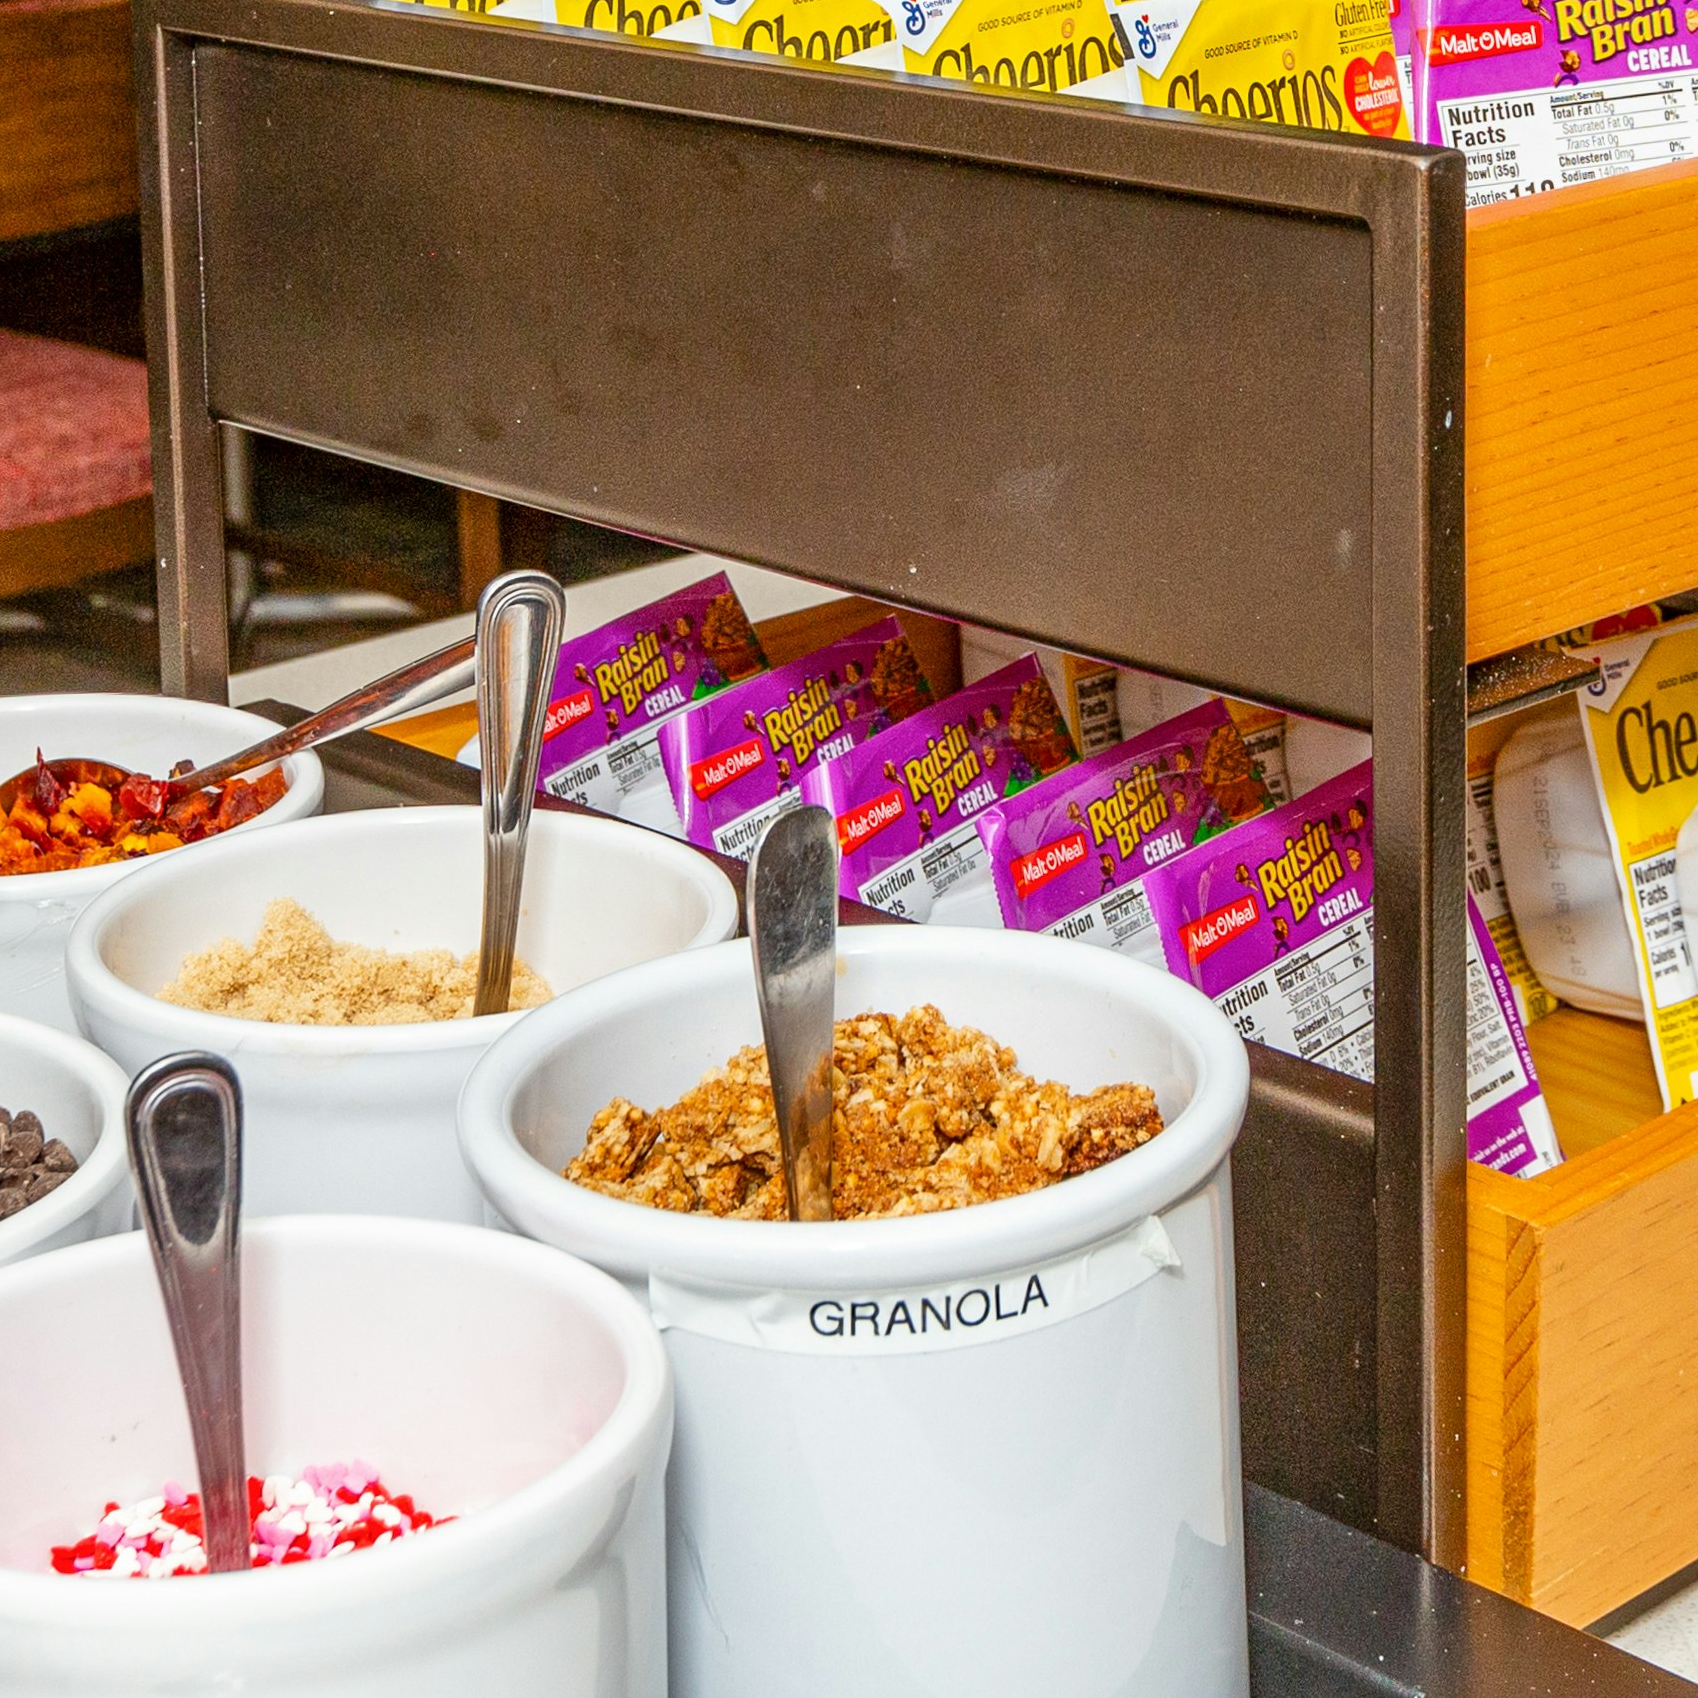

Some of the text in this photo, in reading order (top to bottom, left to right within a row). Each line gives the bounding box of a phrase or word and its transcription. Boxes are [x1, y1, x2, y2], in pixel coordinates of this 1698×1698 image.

[926, 9, 944, 19] Mills
[977, 0, 1083, 33] GOOD SOURCE OF VITAMIN D
[1152, 19, 1179, 33] General
[1334, 0, 1371, 27] Gluten
[1155, 32, 1172, 42] Mills
[1204, 29, 1299, 60] GOOD SOURCE OF VITAMIN D
[1590, 5, 1677, 65] Bran
[1627, 43, 1693, 73] CEREAL
[1447, 100, 1535, 127] Nutrition
[1551, 94, 1678, 120] Total Fat 0.5g 1%
[1562, 109, 1680, 135] Saturated Fat 0g 0%
[1452, 126, 1508, 148] Facts
[1566, 133, 1620, 150] Trans Fat 0g
[1465, 149, 1517, 167] rving size
[1558, 141, 1685, 167] Cholesterol 0mg 0%
[1466, 162, 1521, 182] bowl (35g)
[1561, 168, 1596, 184] Sodium
[1465, 189, 1508, 207] Calories
[592, 631, 662, 705] Raisin
[619, 653, 670, 718] Bran
[644, 684, 687, 718] CEREAL
[762, 673, 832, 755] Raisin
[789, 701, 843, 768] Bran
[816, 733, 855, 766] CEREAL
[551, 763, 601, 797] Nutrition
[903, 721, 971, 806] Raisin
[931, 749, 982, 818] Bran
[957, 780, 999, 817] CEREAL
[1085, 763, 1160, 849] Raisin
[1113, 789, 1170, 862] Bran
[1142, 828, 1186, 866] CEREAL
[1256, 819, 1332, 912] Raisin
[866, 866, 916, 908] Nutrition
[1284, 848, 1346, 925] Bran
[1638, 884, 1669, 909] Facts
[1317, 887, 1364, 927] CEREAL
[1276, 975, 1295, 994] Total
[1294, 969, 1307, 984] Fat
[809, 1273, 1050, 1336] GRANOLA
